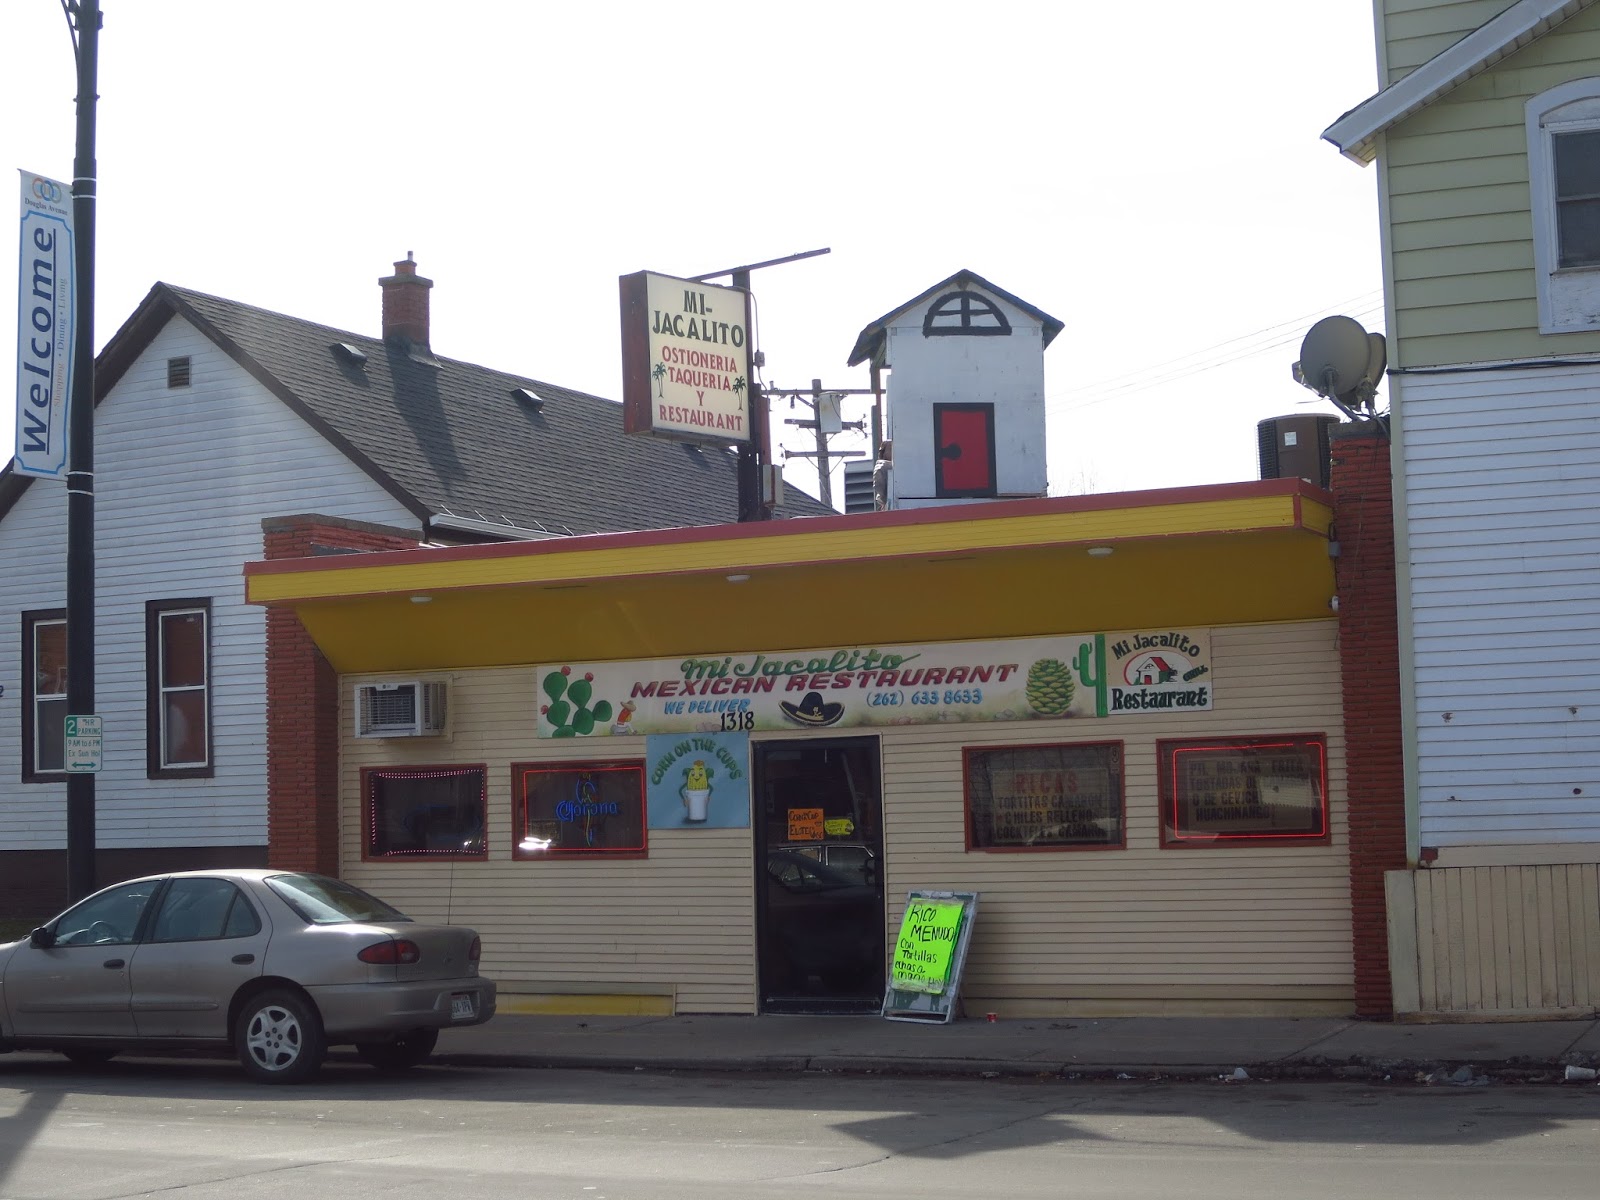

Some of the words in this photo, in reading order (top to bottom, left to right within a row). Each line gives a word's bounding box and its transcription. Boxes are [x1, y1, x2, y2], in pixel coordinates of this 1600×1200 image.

[24, 197, 47, 209] Douglas
[48, 204, 68, 216] Avenue
[59, 278, 67, 309] Living
[23, 227, 54, 453] Welcome
[57, 318, 66, 350] Dining
[652, 310, 745, 348] JACALITO
[662, 345, 737, 373] OSTIONERIA
[53, 362, 65, 407] Shopping
[668, 367, 733, 392] TAQUERIA
[696, 390, 705, 406] Y
[659, 404, 743, 431] RESTAURANT
[1111, 640, 1132, 660] Mi
[1133, 632, 1200, 657] Jacalito
[733, 649, 921, 677] Jacalito
[630, 676, 777, 698] MEXICAN
[785, 663, 1019, 692] RESTAURANT
[664, 701, 685, 714] WE
[688, 698, 751, 714] DELIVER
[866, 690, 905, 708] (262)
[911, 689, 940, 706] 633
[943, 688, 983, 705] 8633
[1111, 687, 1208, 711] Restaurant
[67, 720, 76, 734] 2
[720, 711, 755, 731] 1318
[651, 752, 676, 785] CORN
[674, 740, 692, 757] ON
[692, 738, 716, 753] THE
[716, 747, 742, 780] CUPS
[556, 800, 617, 823] Corona
[909, 904, 937, 923] RICO
[910, 924, 955, 942] MENUDO
[902, 949, 937, 964] Tortillas
